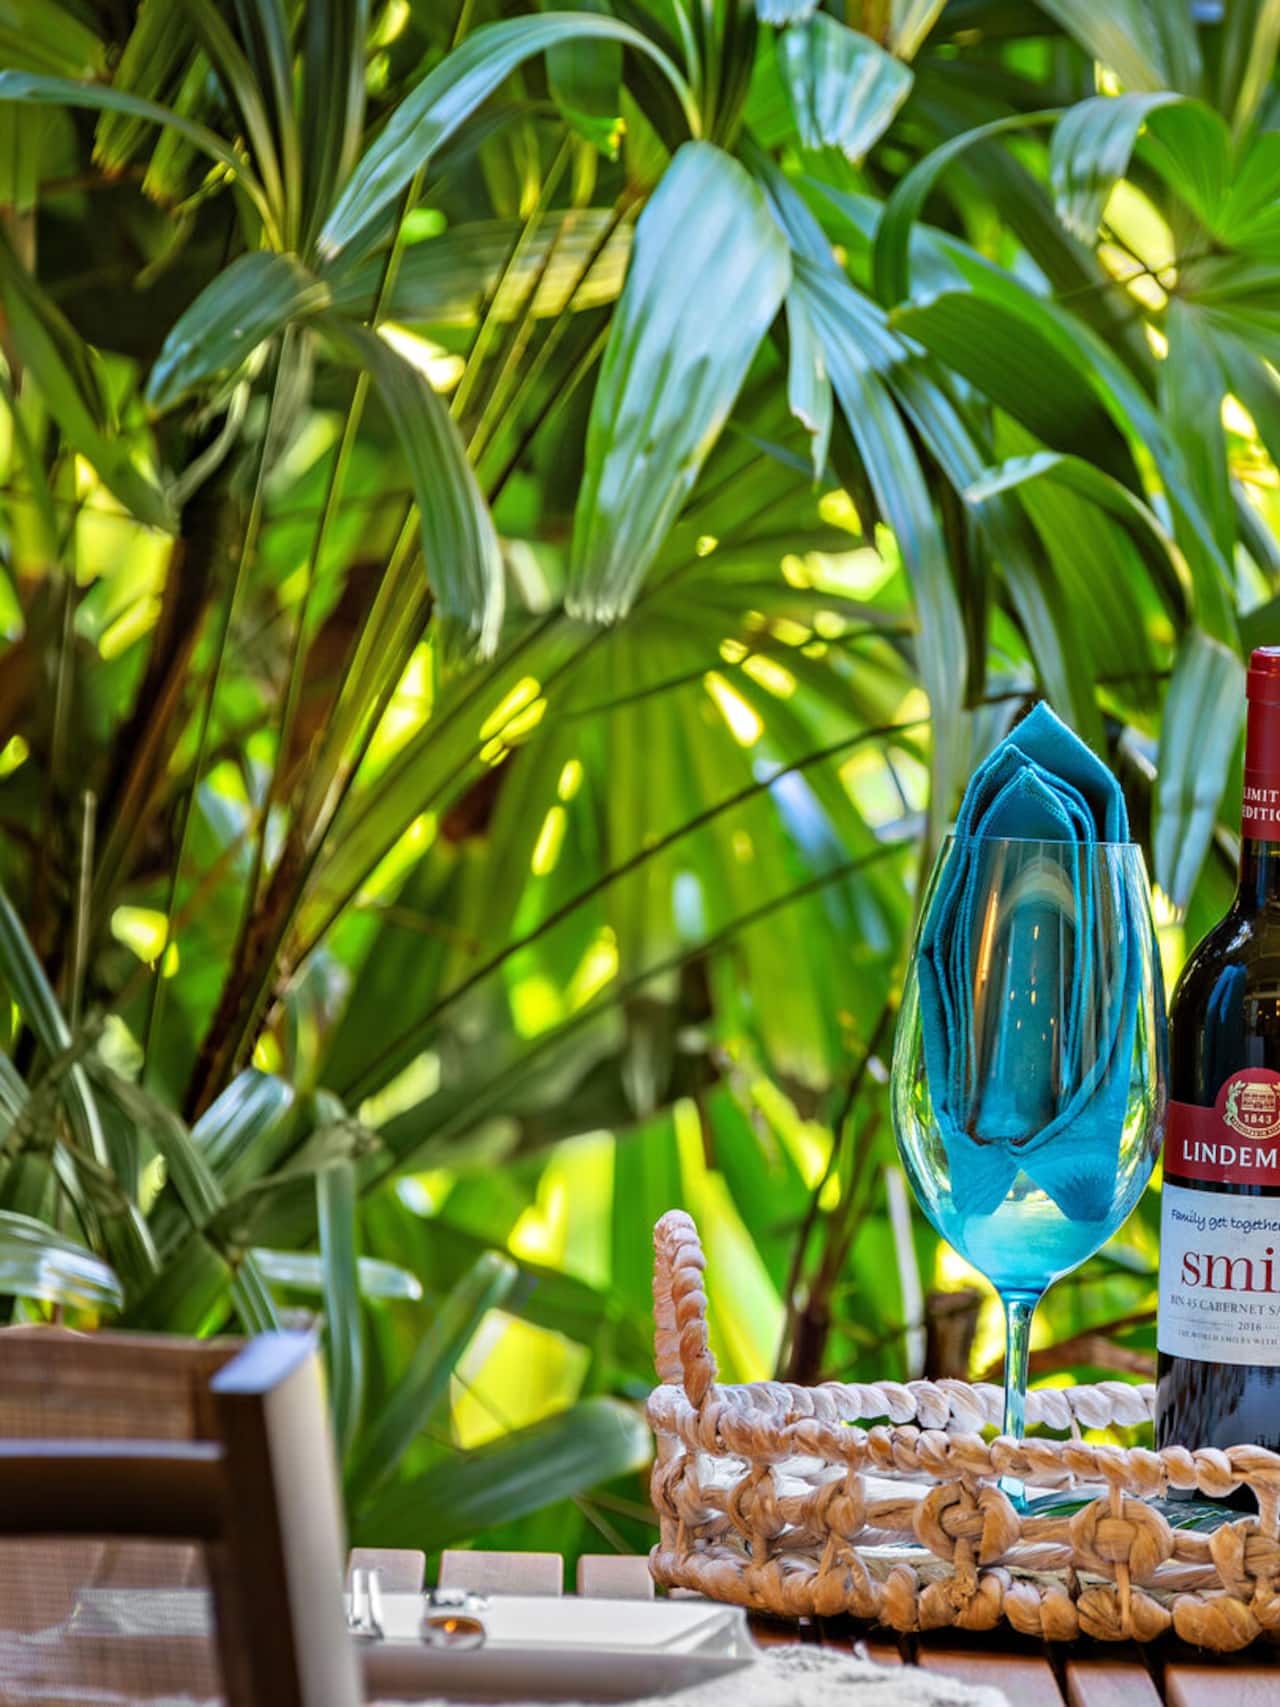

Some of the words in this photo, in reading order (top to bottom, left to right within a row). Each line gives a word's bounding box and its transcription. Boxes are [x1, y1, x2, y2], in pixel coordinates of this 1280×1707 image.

[1244, 1113, 1272, 1124] 1843
[1171, 1209, 1206, 1231] Family
[1208, 1216, 1228, 1231] get
[1199, 1300, 1265, 1315] CABERNET
[1238, 1321, 1262, 1332] 2016
